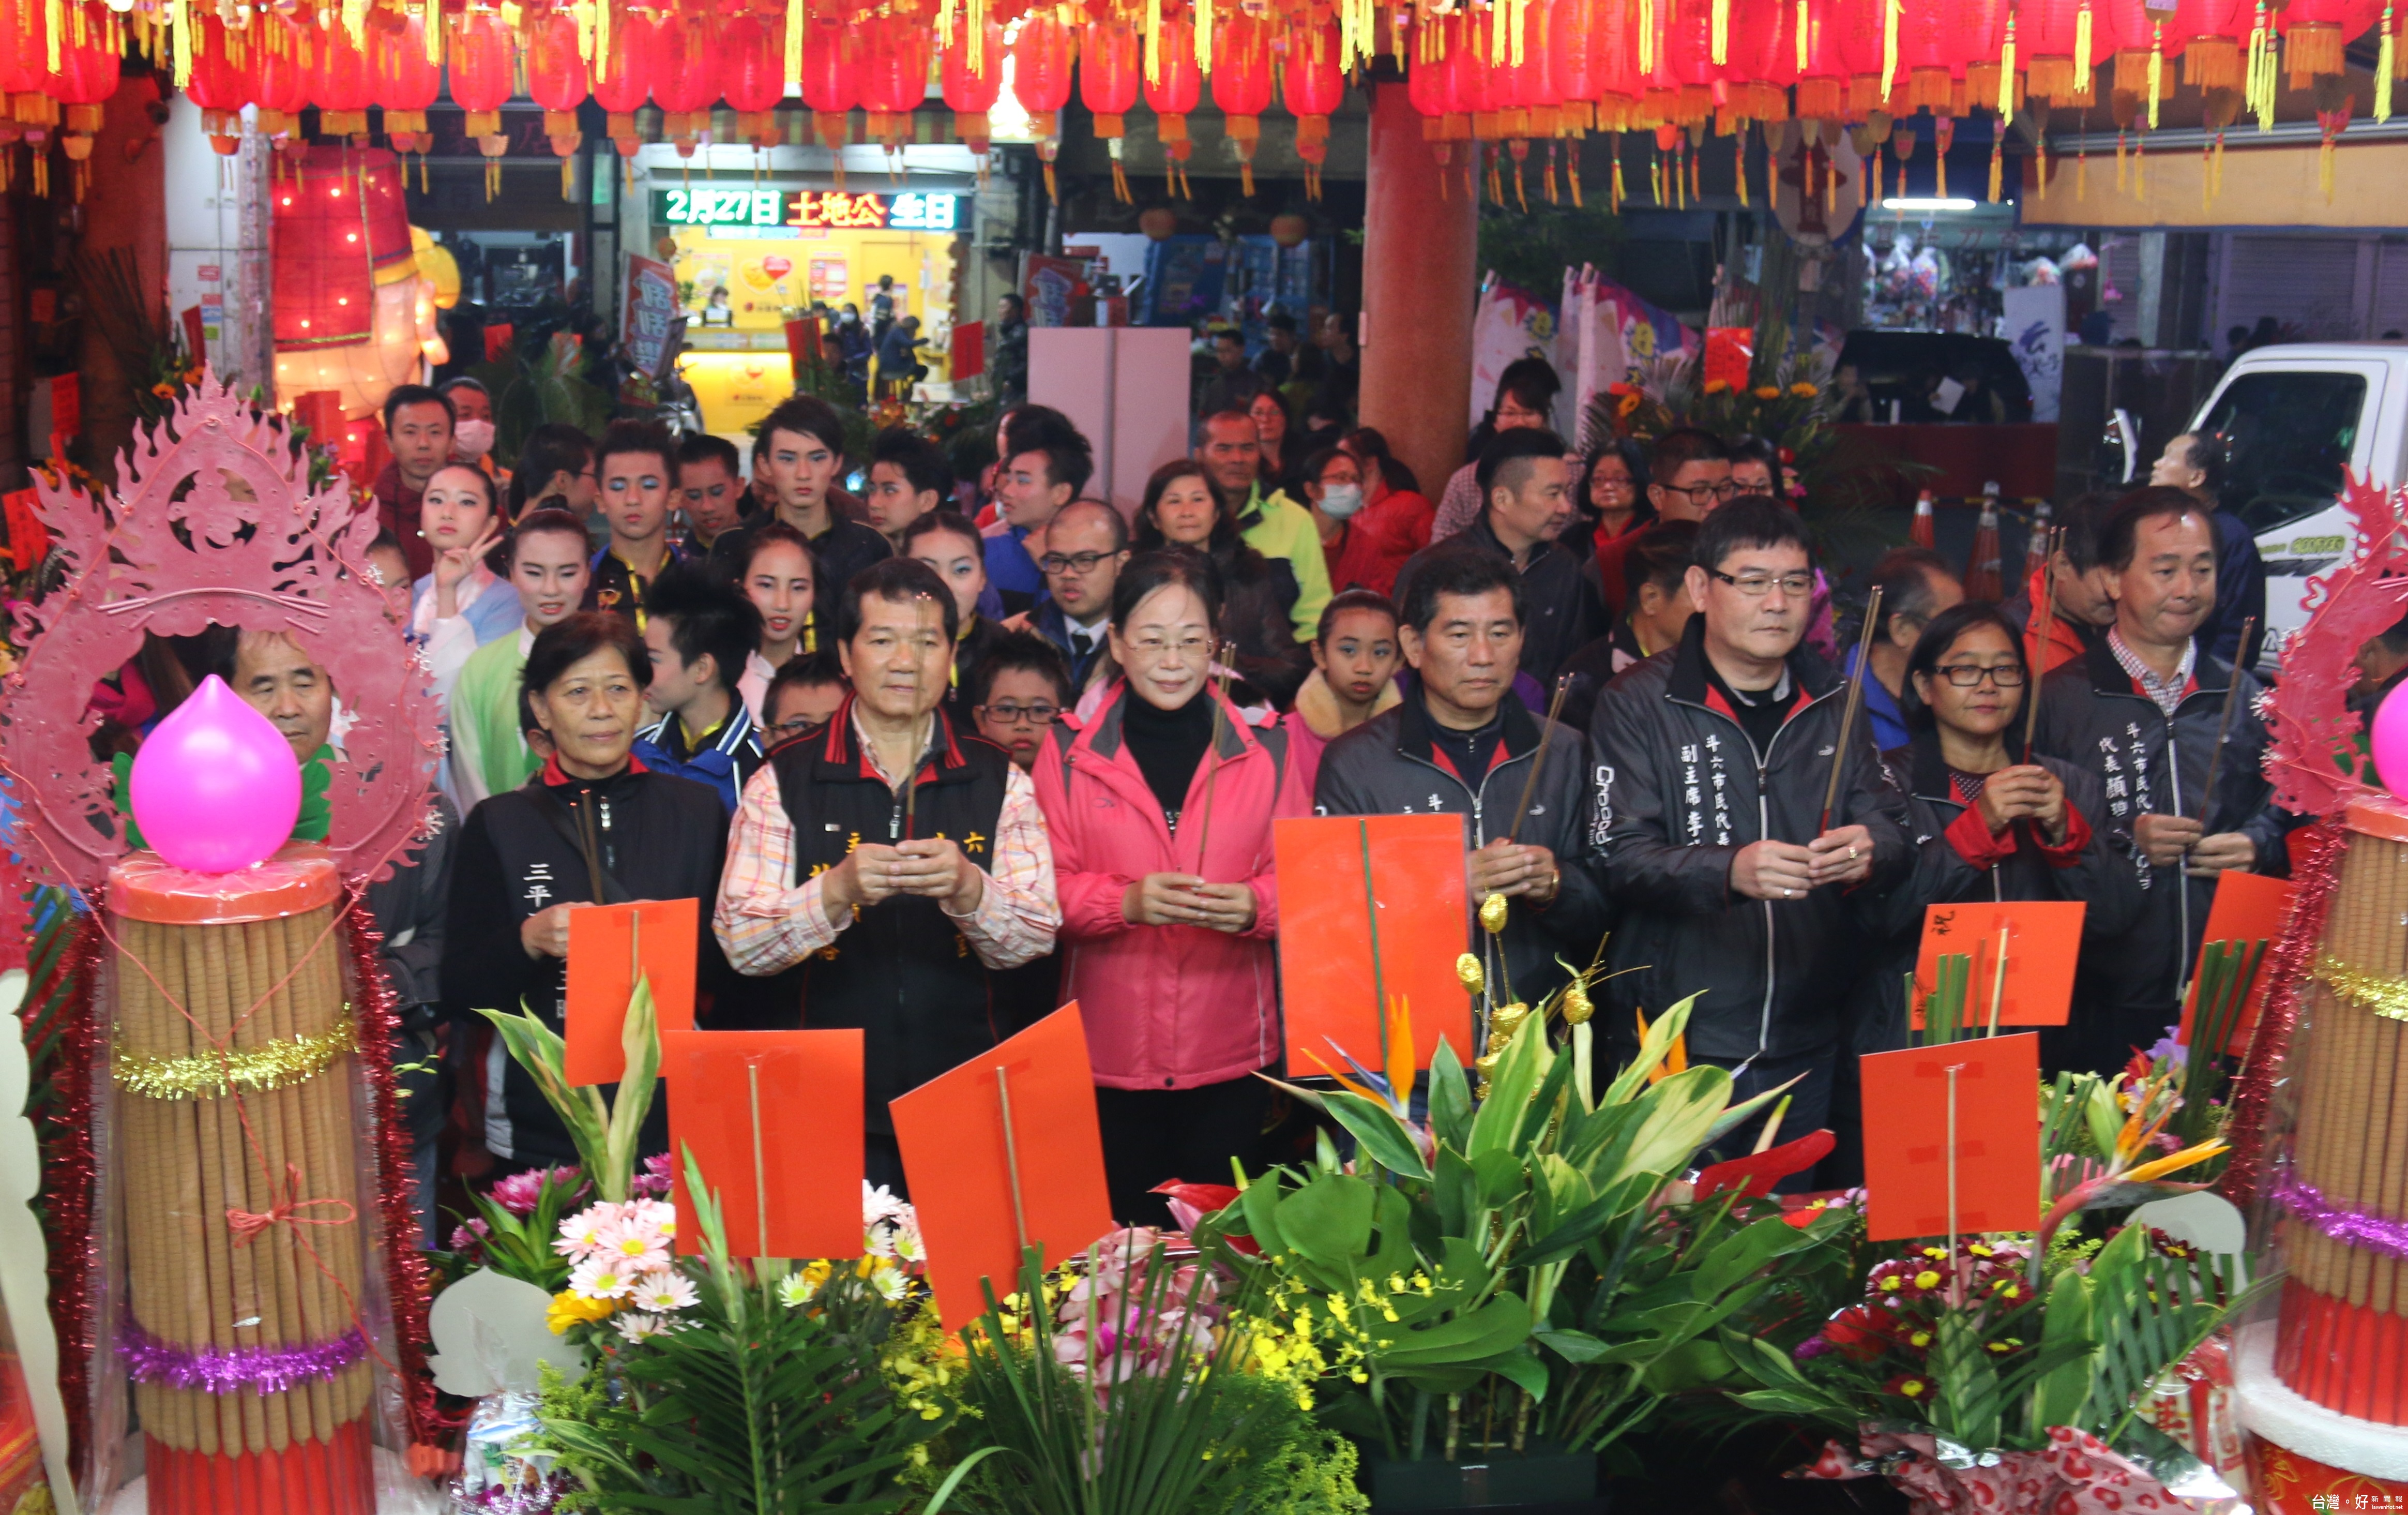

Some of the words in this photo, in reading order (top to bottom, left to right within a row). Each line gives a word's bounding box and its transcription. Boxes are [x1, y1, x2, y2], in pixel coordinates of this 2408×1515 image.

[1680, 744, 1705, 847] 副主席李
[1705, 734, 1732, 846] 斗六市民代表
[2126, 722, 2153, 815] 斗六市民代
[523, 863, 554, 916] 三平
